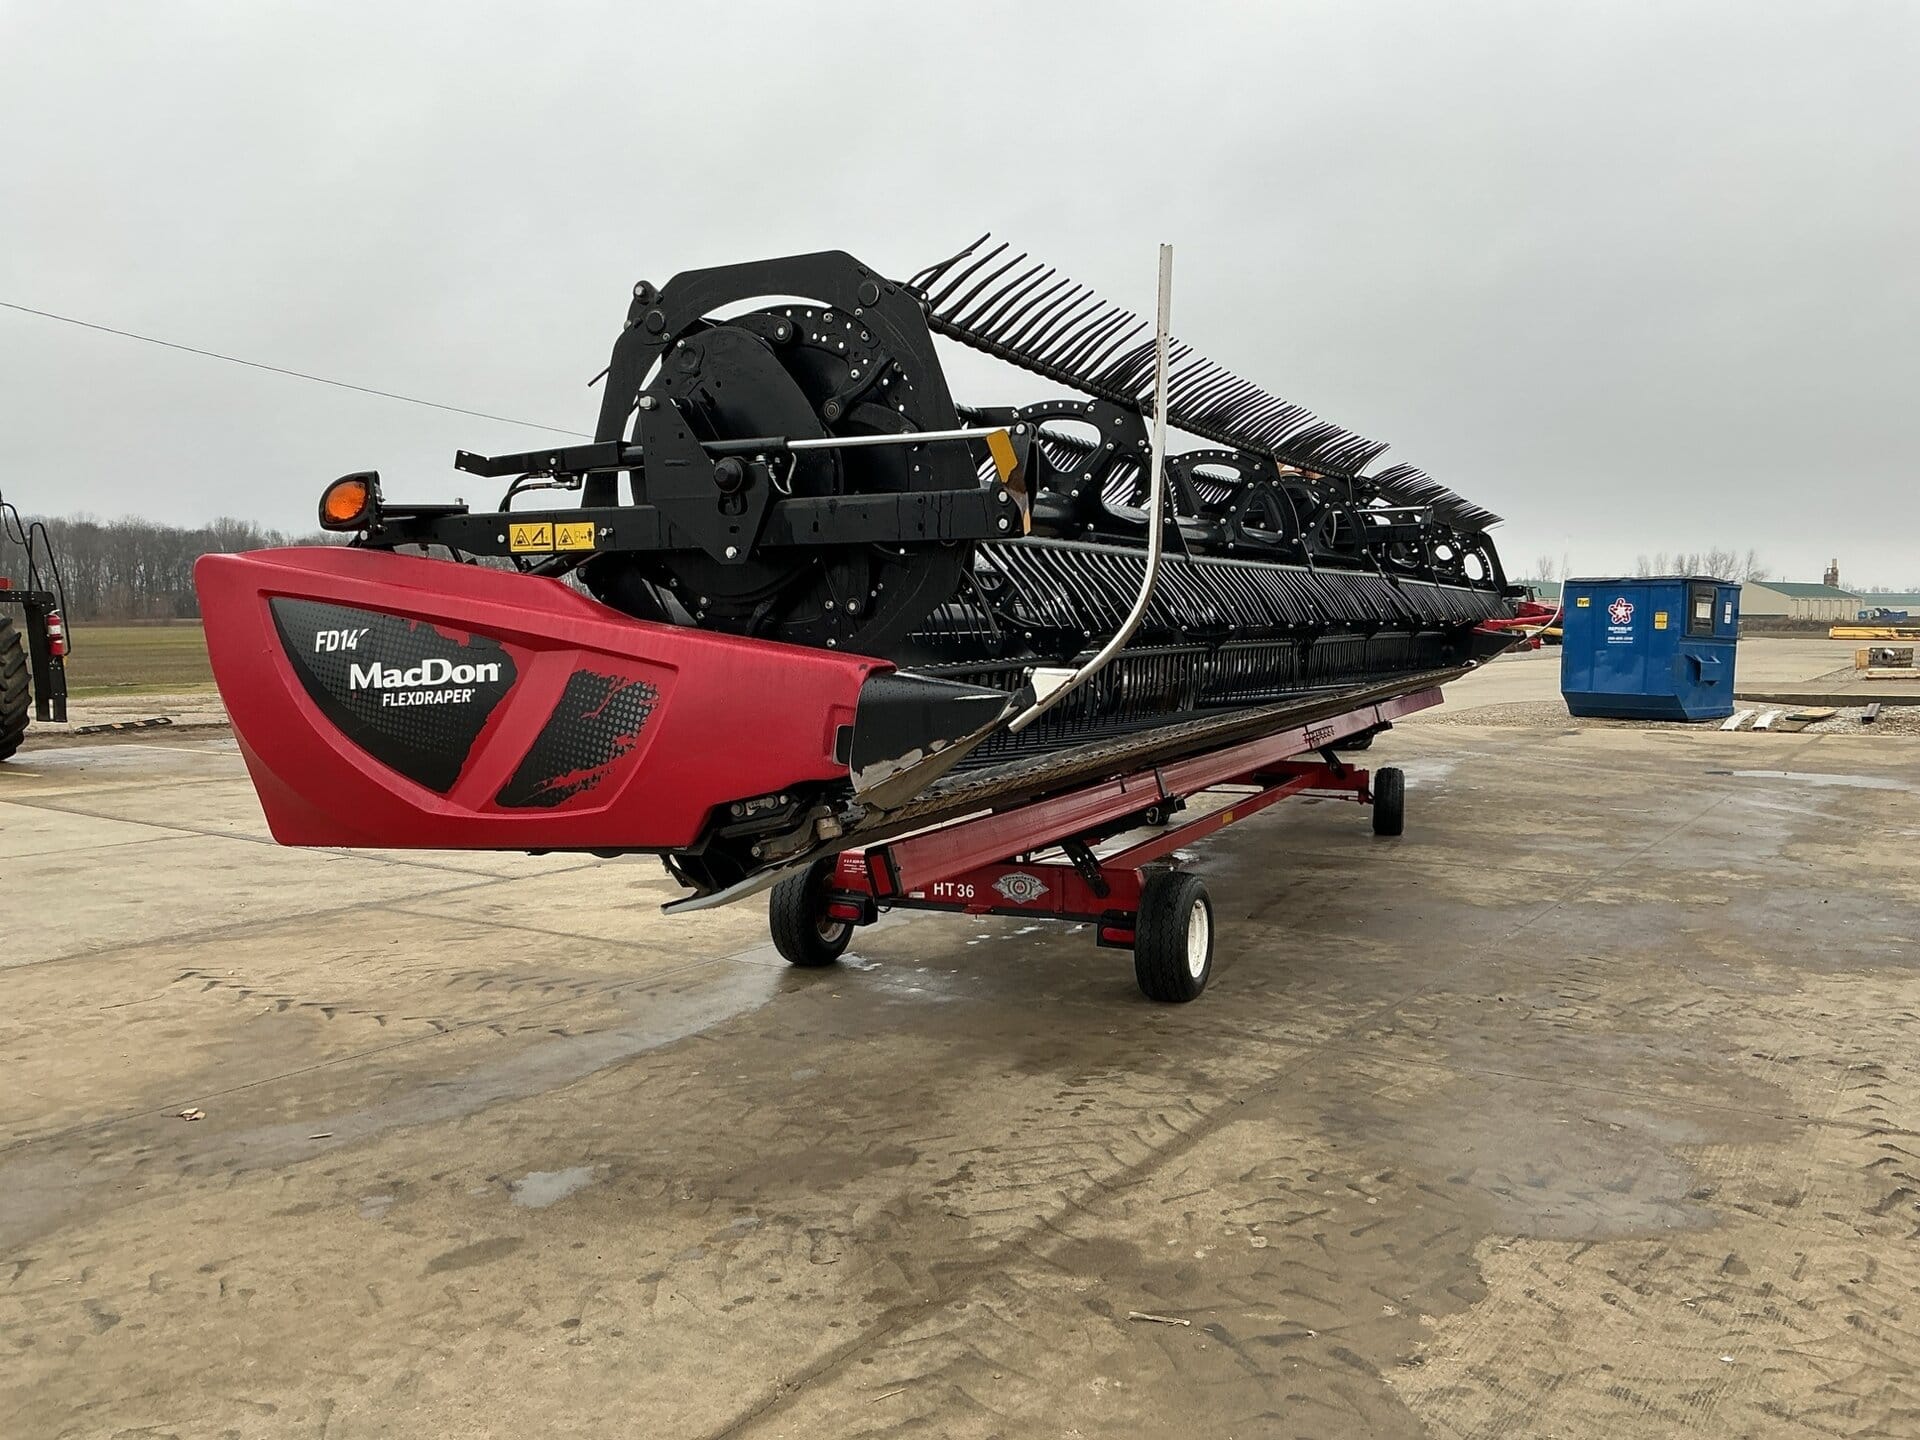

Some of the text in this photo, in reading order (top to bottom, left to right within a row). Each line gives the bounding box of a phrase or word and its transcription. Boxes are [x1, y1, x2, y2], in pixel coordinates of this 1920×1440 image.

[350, 659, 500, 690] MacDon
[382, 689, 474, 707] FLEXDRAPER
[934, 882, 955, 897] HT
[957, 883, 975, 898] 36
